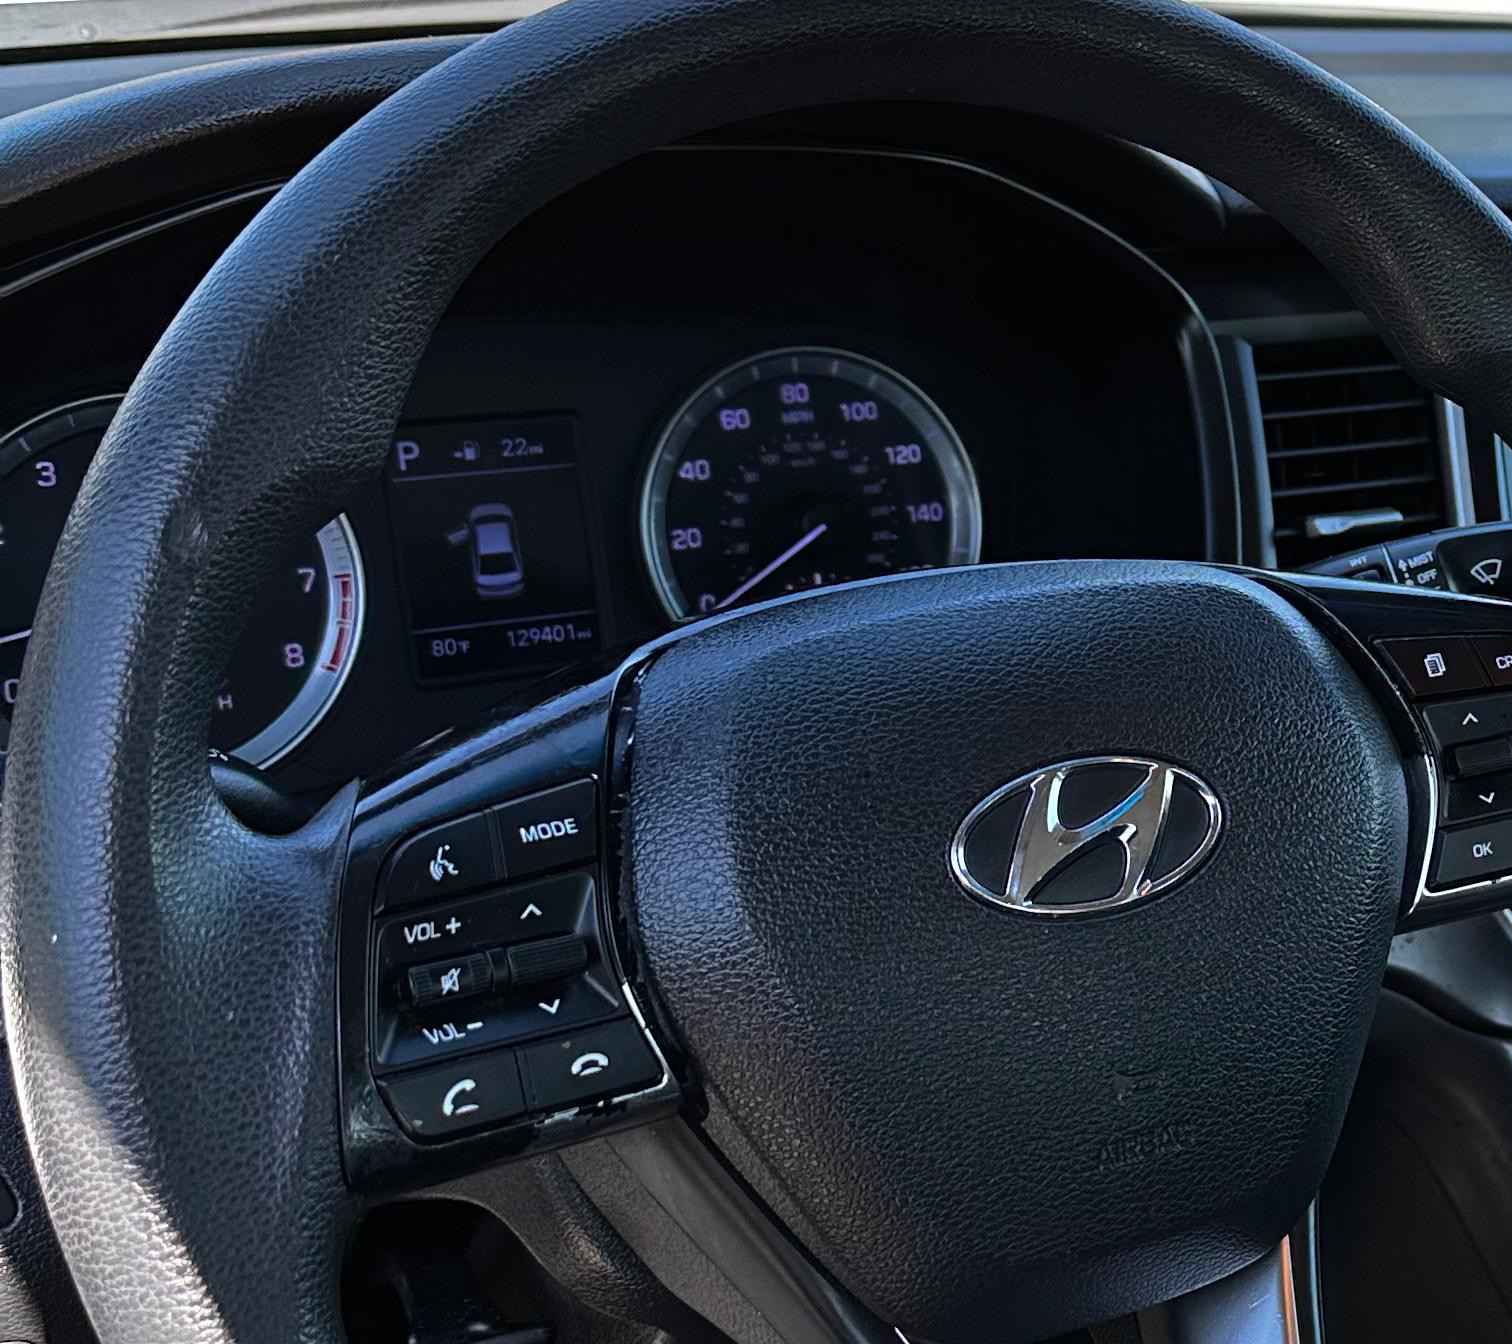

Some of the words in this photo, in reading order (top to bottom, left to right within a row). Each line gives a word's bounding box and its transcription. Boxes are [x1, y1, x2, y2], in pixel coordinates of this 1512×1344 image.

[779, 383, 809, 404] 80
[719, 408, 750, 430] 60
[840, 400, 879, 422] 100
[396, 440, 421, 472] P
[885, 443, 922, 466] 120
[34, 461, 58, 488] 3
[678, 459, 711, 481] 40
[907, 502, 943, 523] 140
[671, 528, 703, 550] 20
[1407, 551, 1434, 568] MIST
[296, 568, 316, 594] 7
[1417, 568, 1438, 584] OFF
[282, 643, 305, 668] 8
[519, 817, 579, 844] MODE
[1472, 840, 1493, 858] OK
[404, 922, 440, 944] VOL
[422, 1022, 465, 1045] VOL
